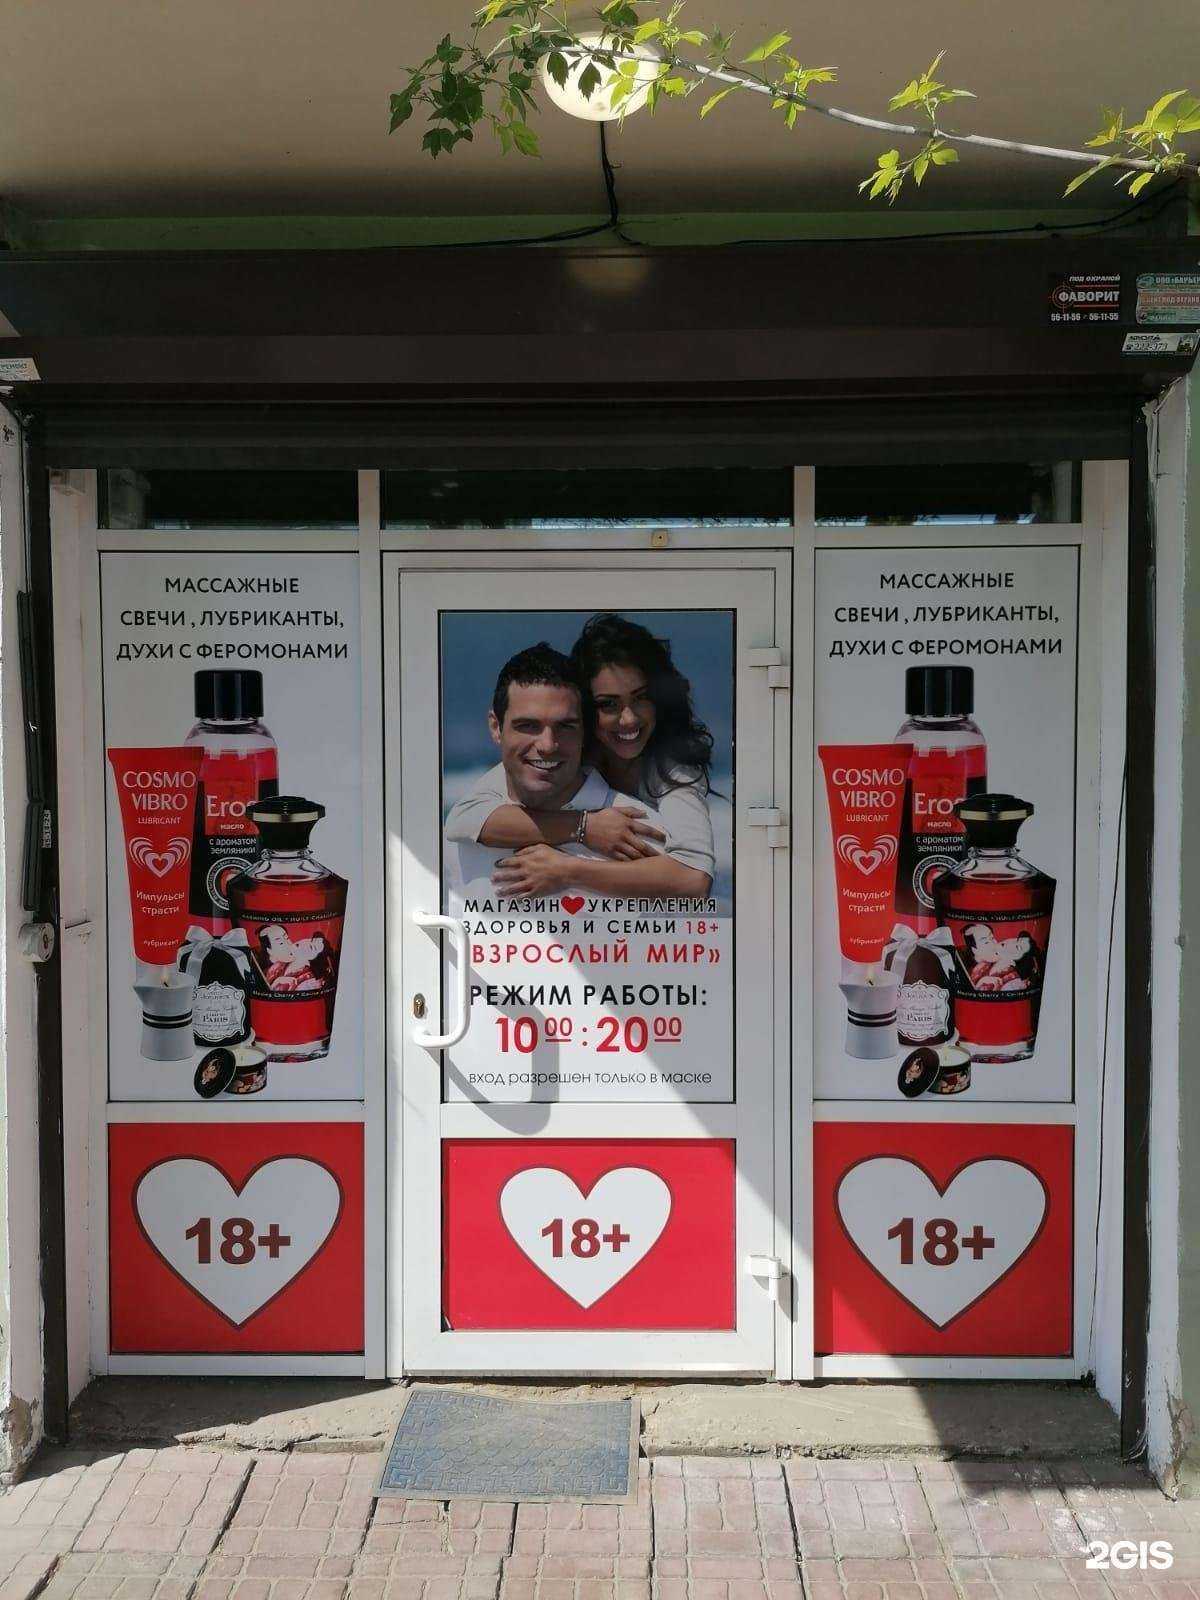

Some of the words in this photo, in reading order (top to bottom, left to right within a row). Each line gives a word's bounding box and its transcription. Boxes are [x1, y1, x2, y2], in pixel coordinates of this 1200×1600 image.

[1058, 291, 1120, 302] ФАВОРИТ
[165, 577, 300, 593] МАССАЖНЫЕ
[880, 572, 1015, 589] МАССАЖНЫЕ
[199, 610, 345, 629] ЛУБРИКАНТЫ,
[913, 604, 1060, 623] ЛУБРИКАНТЫ,
[116, 644, 174, 661] ДУХИ
[179, 644, 192, 659] С
[196, 643, 348, 659] ФЕРОМОНАМИ
[829, 640, 886, 658] ДУХИ
[891, 639, 904, 655] С
[908, 638, 1062, 655] ФЕРОМОНАМИ
[122, 770, 197, 789] COSMO
[832, 768, 905, 786] COSMO
[131, 793, 188, 811] VIBRO
[840, 790, 896, 808] VIBRO
[137, 816, 182, 825] LUBRICANT
[846, 814, 889, 822] LUBRICANT
[136, 890, 185, 903] Импульсы
[842, 888, 891, 902] Импульсы
[142, 906, 180, 917] страсти
[463, 899, 560, 913] МАГАЗИН
[587, 898, 717, 913] УКРЕПЛЕНИЯ
[848, 904, 886, 915] страсти
[464, 920, 570, 935] ЗДОРОВЬЯ
[583, 920, 594, 934] И
[607, 920, 677, 934] СЕМЬИ
[686, 920, 720, 934] 18+
[646, 943, 721, 963] МИР»
[470, 985, 571, 1006] РЕЖИМ
[583, 984, 707, 1006] РАБОТЫ:
[469, 1072, 506, 1086] вход
[508, 1072, 591, 1089] разрешен
[595, 1072, 646, 1085] только
[650, 1072, 658, 1084] в
[661, 1072, 712, 1084] маске
[185, 1217, 292, 1265] 18+
[540, 1218, 630, 1259] 18+
[887, 1217, 996, 1266] 18+
